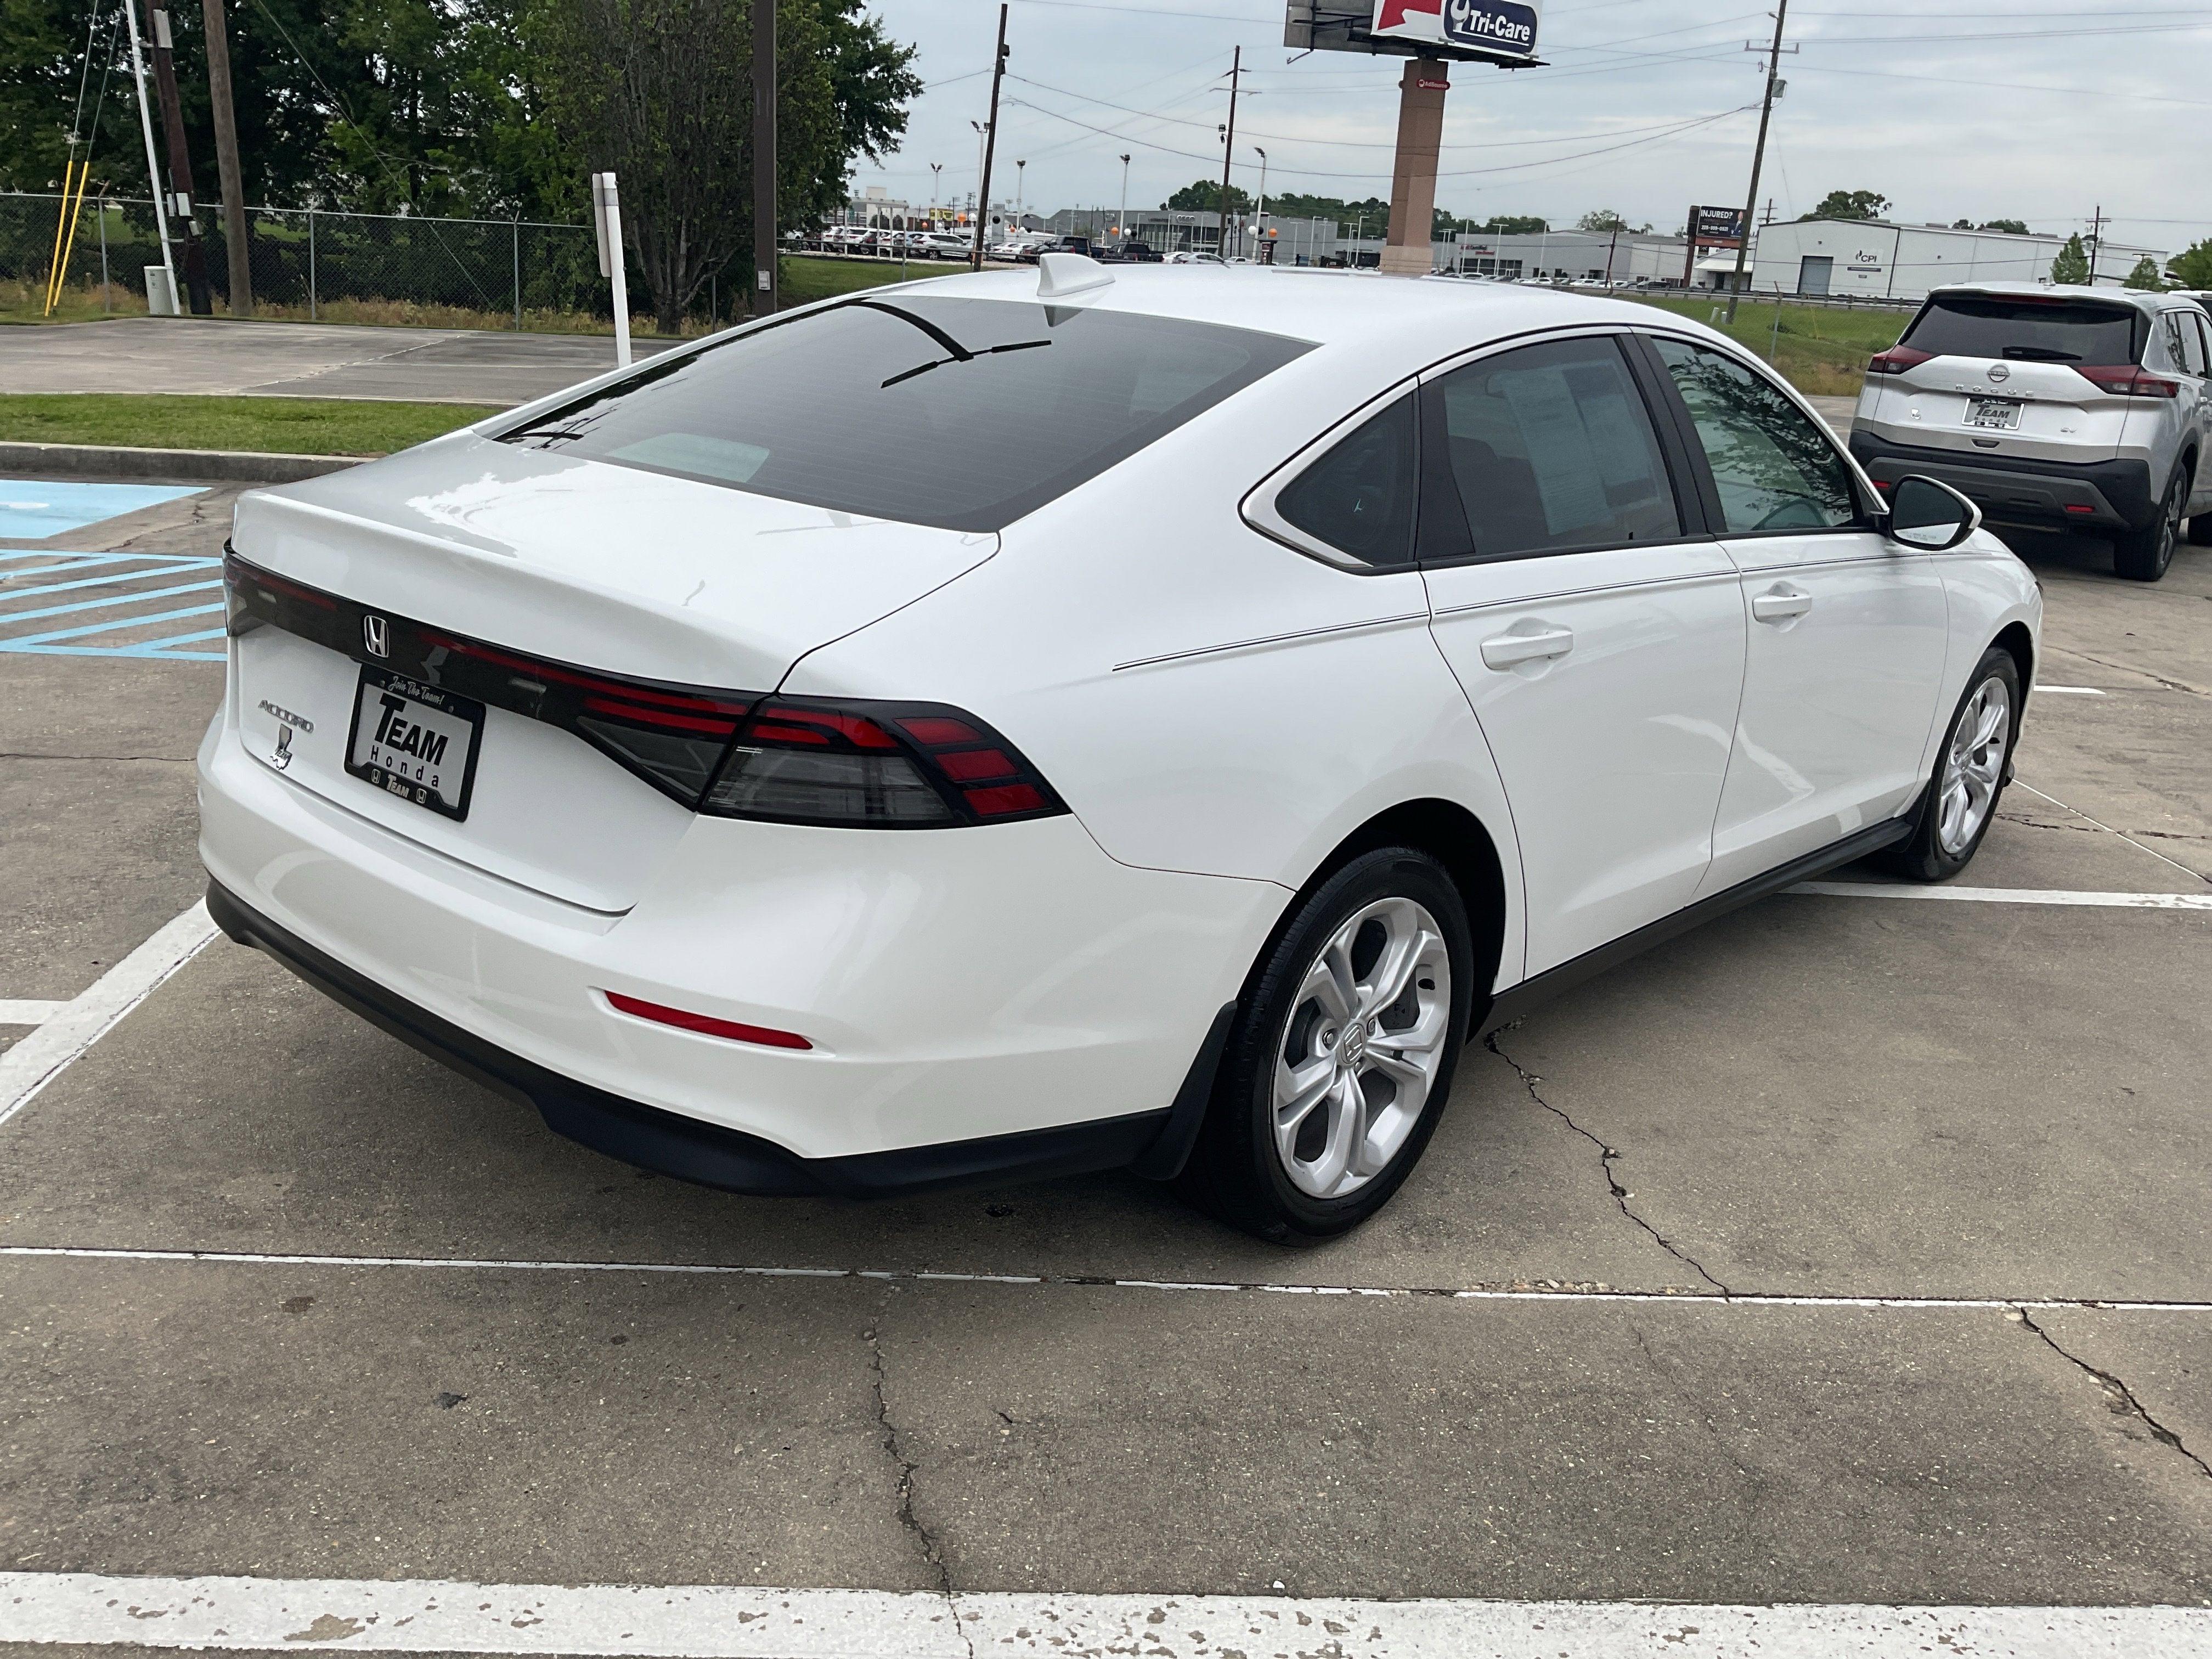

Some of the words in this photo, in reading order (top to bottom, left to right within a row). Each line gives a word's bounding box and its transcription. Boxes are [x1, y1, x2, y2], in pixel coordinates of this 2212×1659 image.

[1470, 9, 1530, 41] Tri-Care
[1701, 210, 1733, 219] INJURED?
[1861, 255, 1877, 263] CPI
[1976, 404, 2011, 419] TEAM
[388, 675, 407, 692] Join
[408, 681, 420, 696] The
[421, 686, 445, 705] Team!
[258, 699, 314, 733] ACCORD
[374, 692, 449, 766] TEAM
[370, 744, 439, 788] Honda
[386, 774, 410, 798] TEAM
